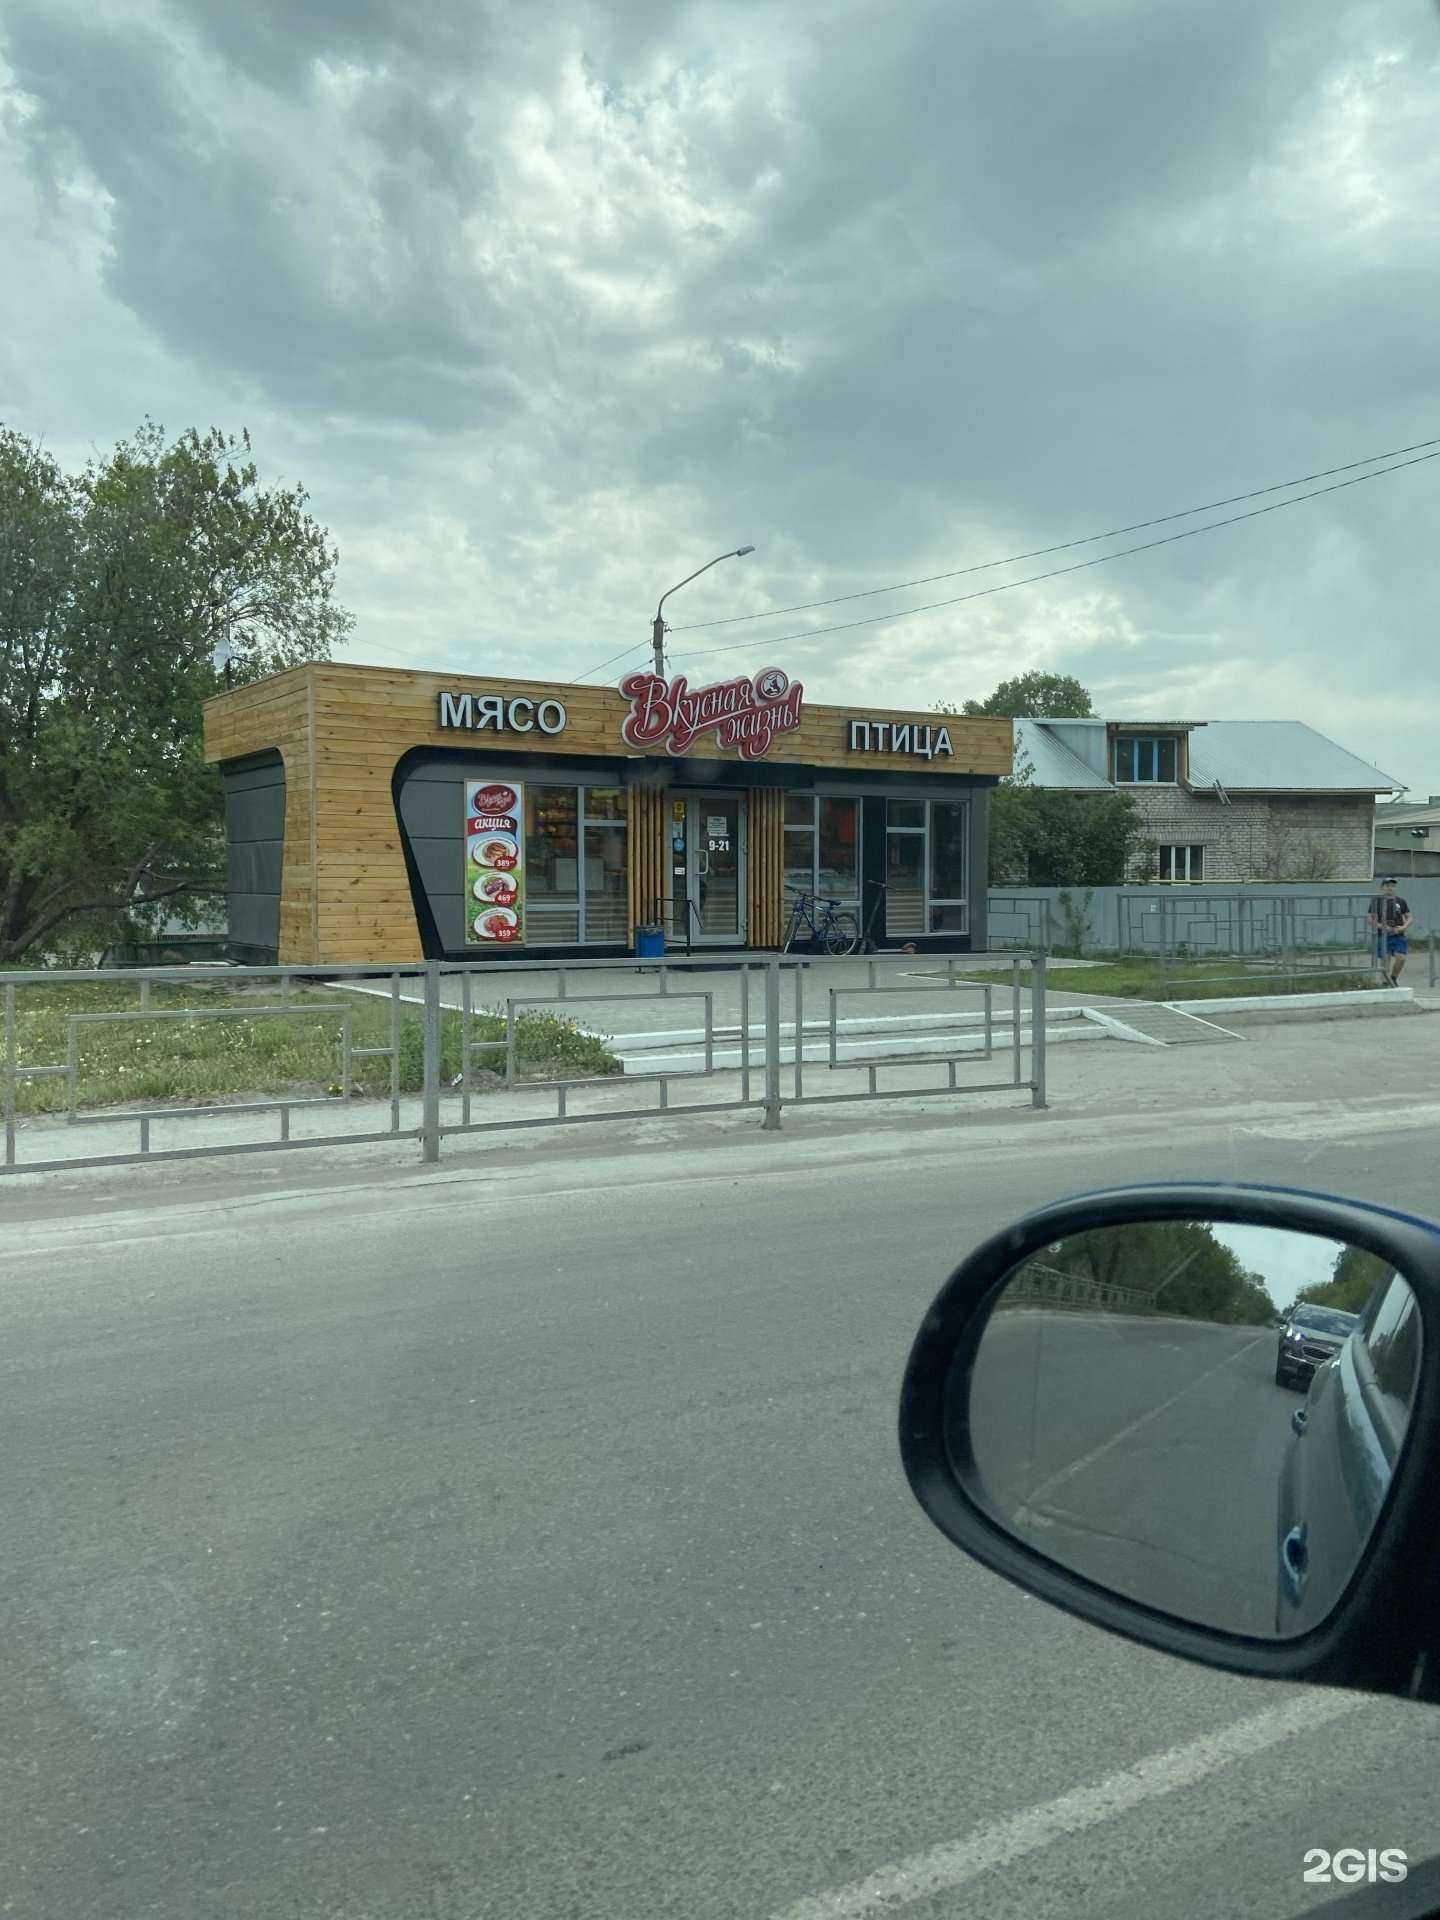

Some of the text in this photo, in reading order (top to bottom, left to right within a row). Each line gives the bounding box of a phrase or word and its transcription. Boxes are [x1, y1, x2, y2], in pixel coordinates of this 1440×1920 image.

[440, 692, 566, 734] МЯСО
[632, 680, 752, 747] Вкусная
[727, 689, 801, 756] жизнь!
[850, 721, 954, 760] ПТИЦА
[475, 818, 511, 831] акция
[708, 839, 730, 851] 9-21
